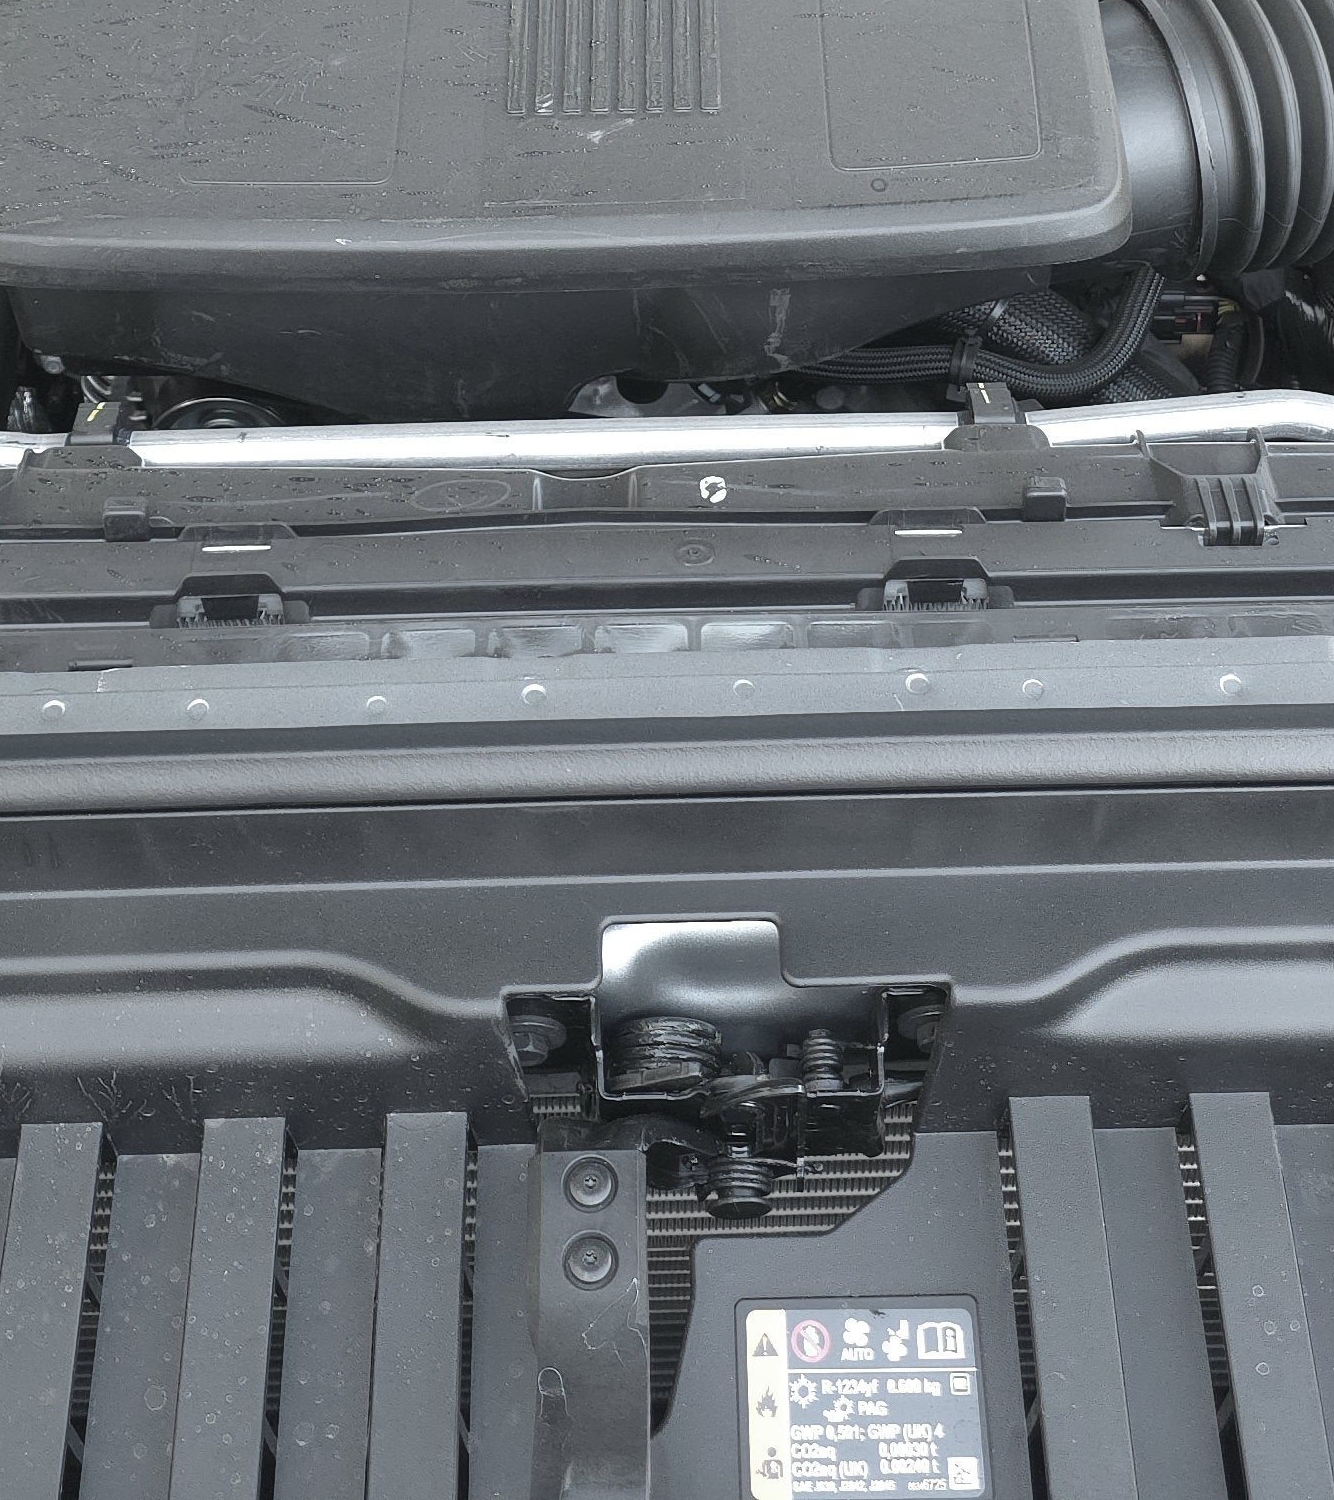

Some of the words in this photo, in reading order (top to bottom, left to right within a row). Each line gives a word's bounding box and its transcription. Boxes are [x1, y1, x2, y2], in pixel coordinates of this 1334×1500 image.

[841, 1348, 874, 1361] AUTO
[821, 1378, 879, 1397] R-1234yf
[923, 1377, 942, 1397] kg
[857, 1400, 889, 1416] PAG
[790, 1424, 825, 1441] GWP
[867, 1423, 901, 1440] GWP
[903, 1423, 932, 1442] (UK)
[933, 1422, 945, 1439] 4
[929, 1441, 939, 1457] t
[839, 1460, 869, 1479] (UK)
[931, 1458, 941, 1474] t
